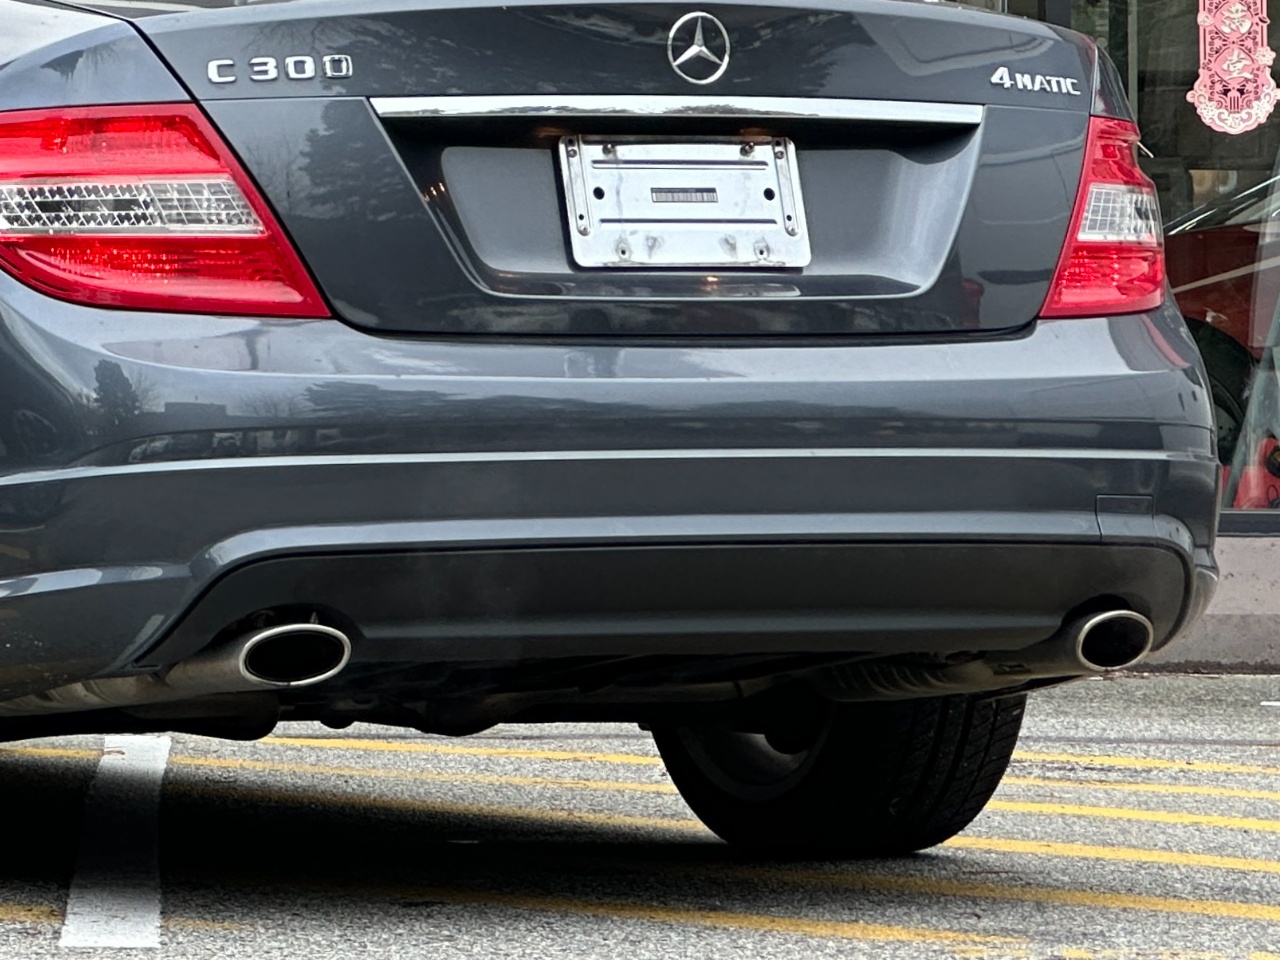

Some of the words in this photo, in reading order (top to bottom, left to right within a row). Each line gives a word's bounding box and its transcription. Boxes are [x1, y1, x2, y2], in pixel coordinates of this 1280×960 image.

[208, 60, 235, 82] C
[251, 55, 352, 79] 300
[991, 67, 1080, 94] 4MATIC
